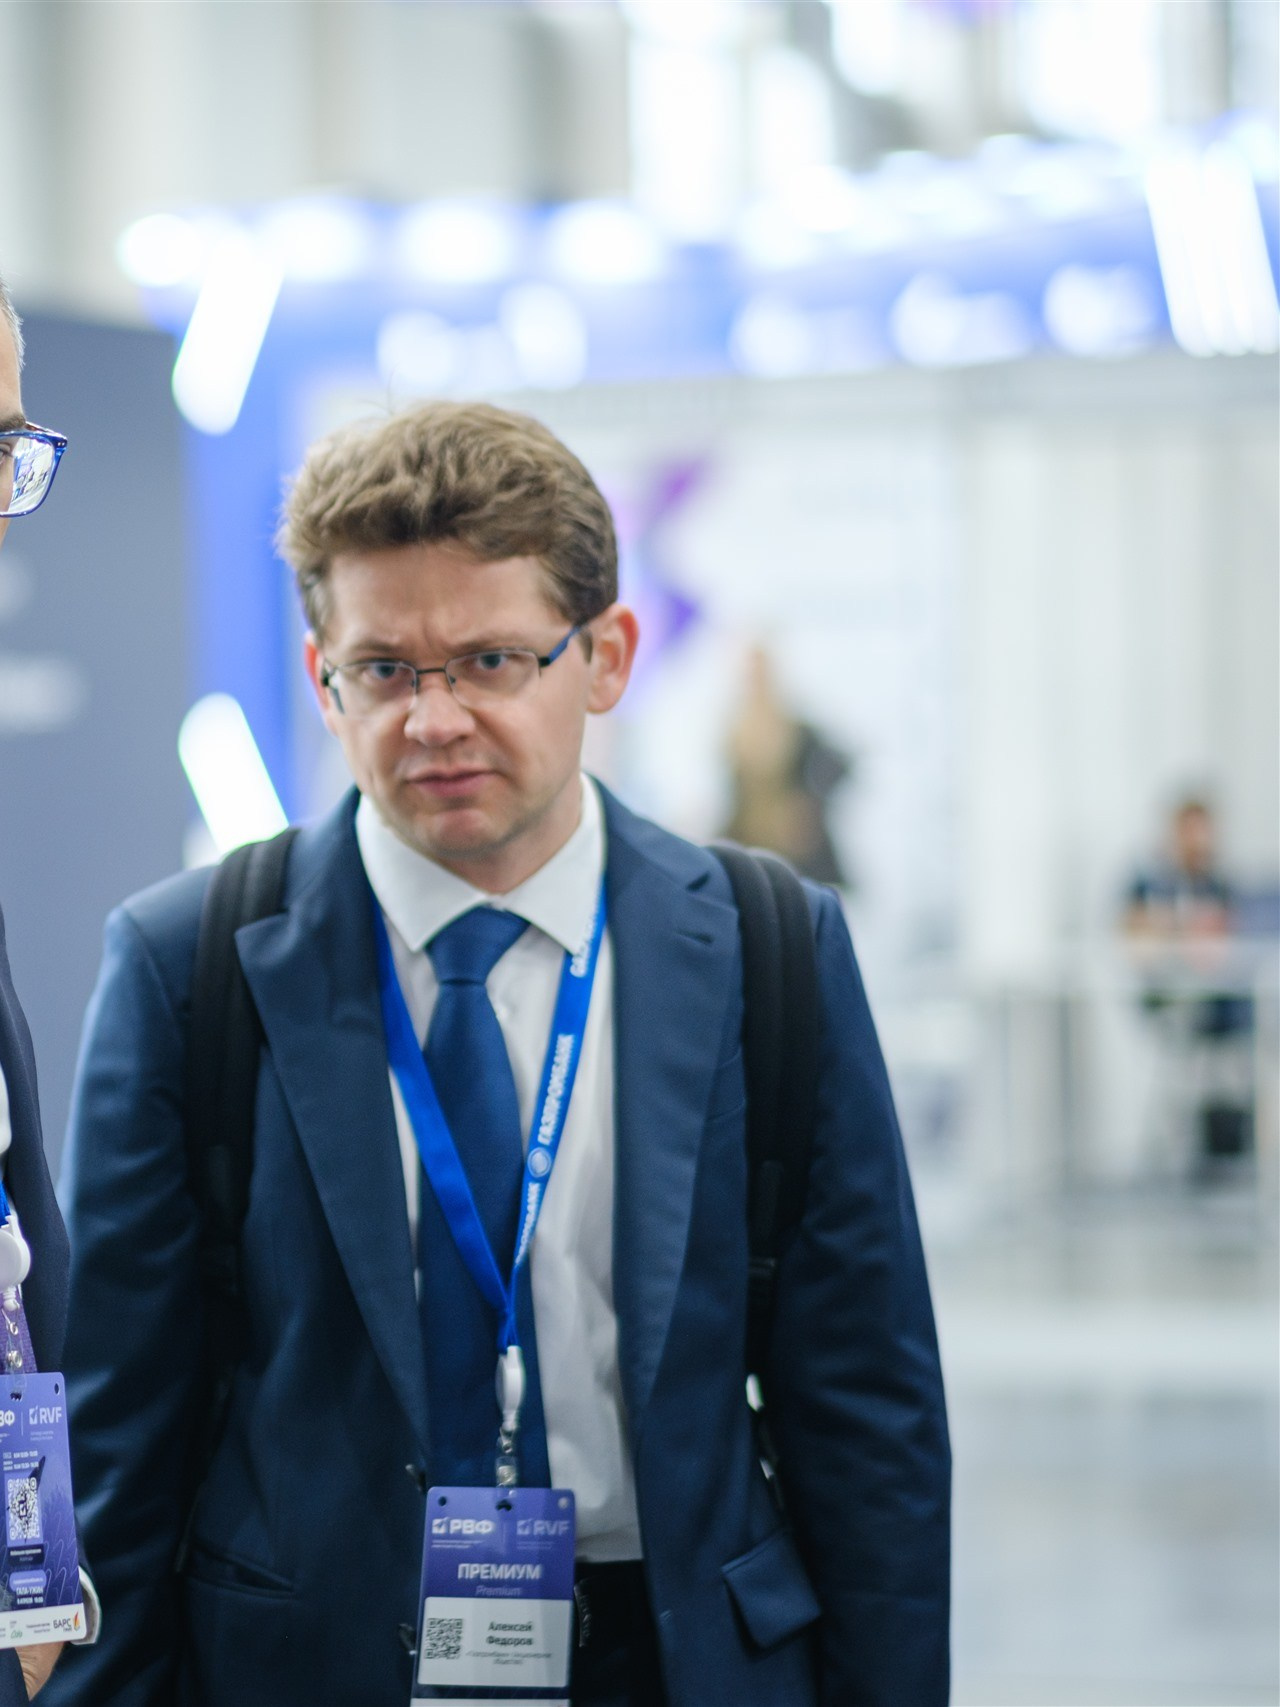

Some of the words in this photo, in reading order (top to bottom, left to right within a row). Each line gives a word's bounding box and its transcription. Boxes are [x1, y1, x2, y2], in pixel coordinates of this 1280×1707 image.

[39, 1407, 62, 1424] RVF
[450, 1519, 495, 1535] РВФ
[533, 1520, 570, 1536] RVF
[457, 1563, 542, 1580] ПРЕМИУМ
[475, 1585, 523, 1596] Premium
[53, 1618, 71, 1629] БАРС
[488, 1621, 533, 1631] Алексей
